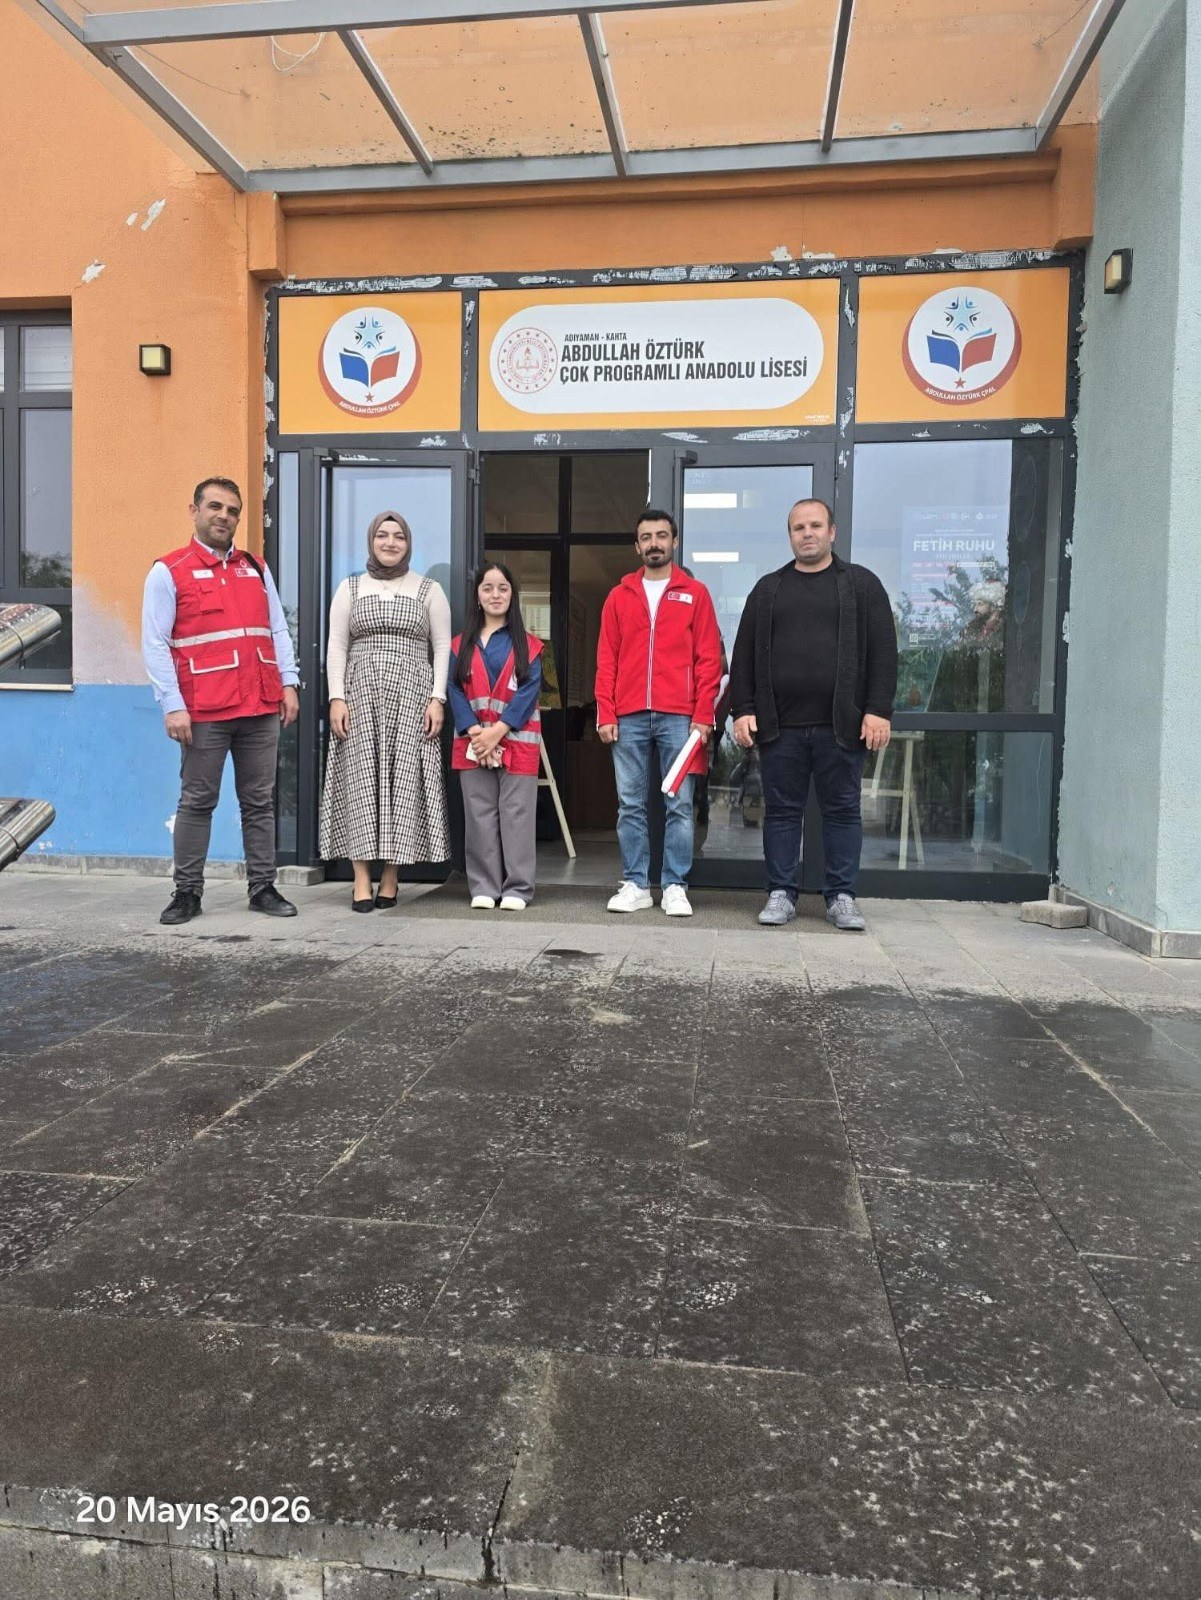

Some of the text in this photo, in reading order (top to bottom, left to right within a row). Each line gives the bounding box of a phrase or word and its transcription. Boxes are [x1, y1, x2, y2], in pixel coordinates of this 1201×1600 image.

[564, 333, 600, 342] ADIYAMAN
[605, 332, 628, 341] KAHTA
[561, 343, 640, 362] ABDULLAH
[645, 338, 705, 360] ÖZTÜRK
[560, 356, 807, 385] ÇOK PROGRAMLI ANADOLU LİSESİ
[925, 387, 956, 400] ABDULLAH
[339, 401, 366, 413] ABDULLAH
[913, 538, 995, 552] FETİH RUHU
